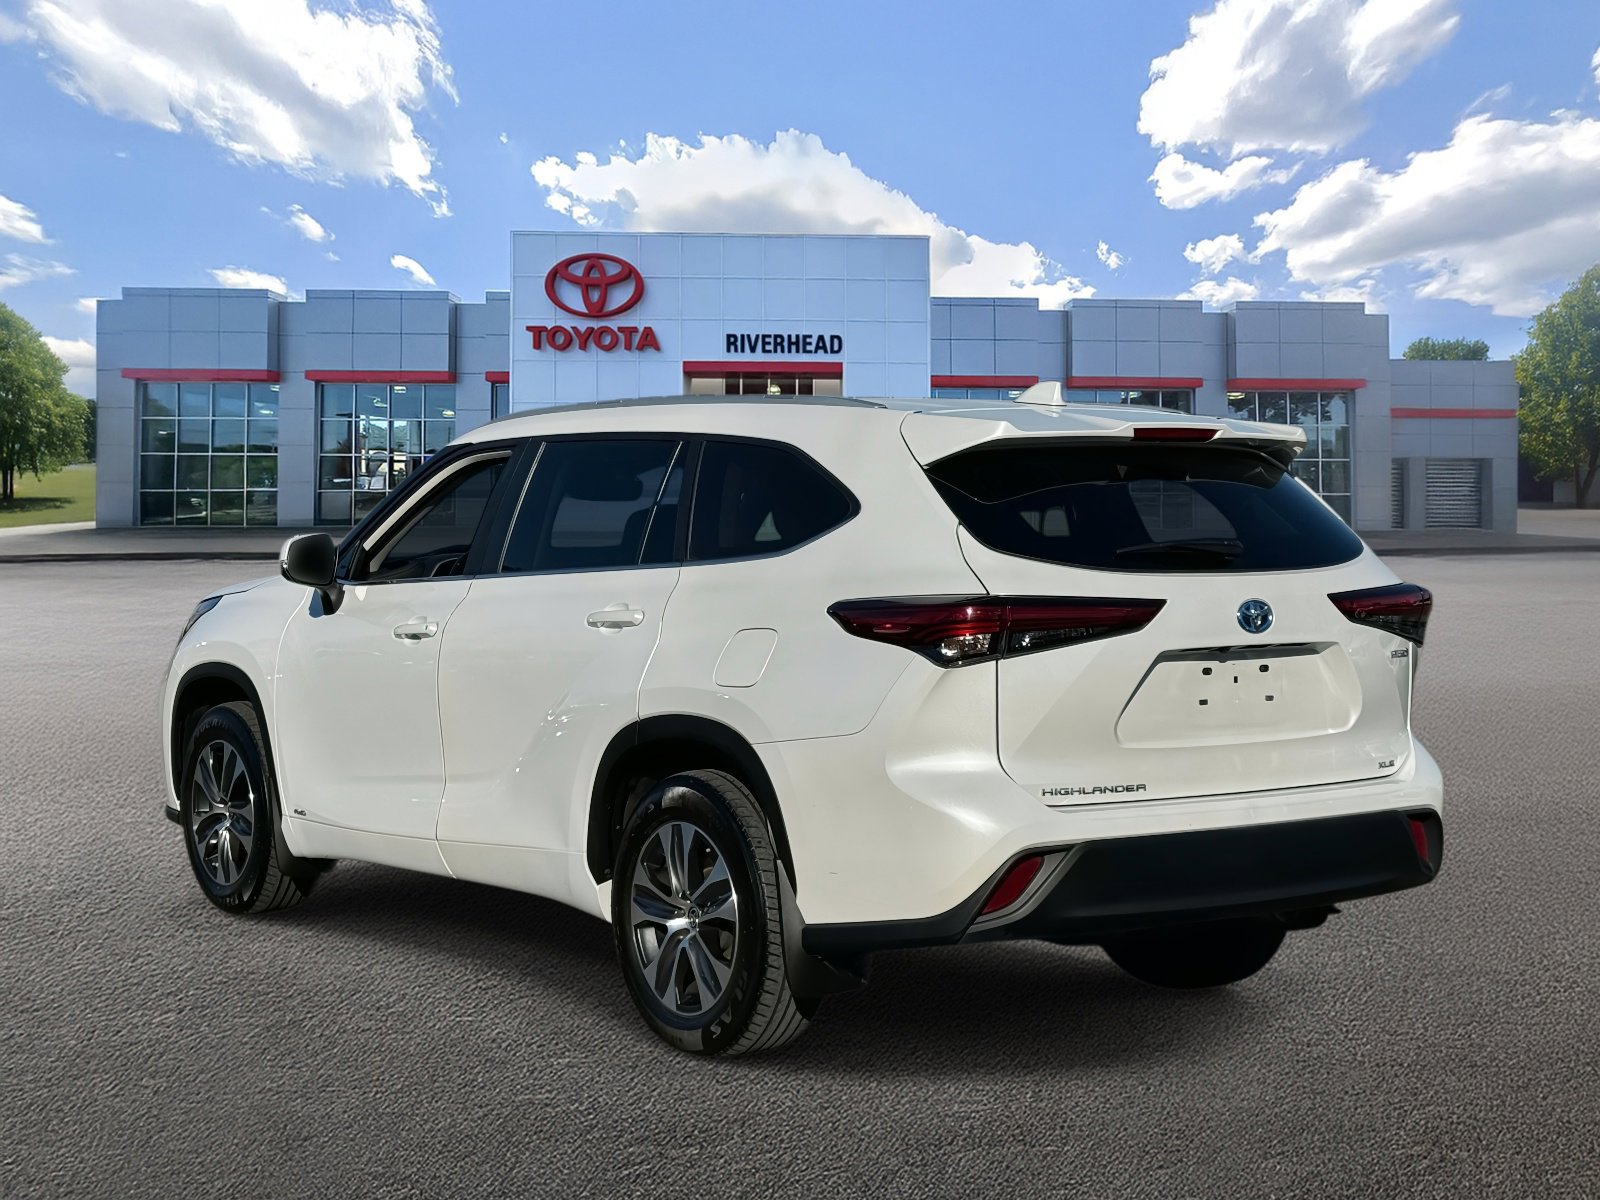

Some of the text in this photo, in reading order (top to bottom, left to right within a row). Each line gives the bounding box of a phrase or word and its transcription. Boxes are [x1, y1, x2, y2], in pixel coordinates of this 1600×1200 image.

[526, 325, 661, 352] TOYOTA
[726, 333, 843, 354] RIVERHEAD
[1042, 783, 1147, 797] HIGHLANDER
